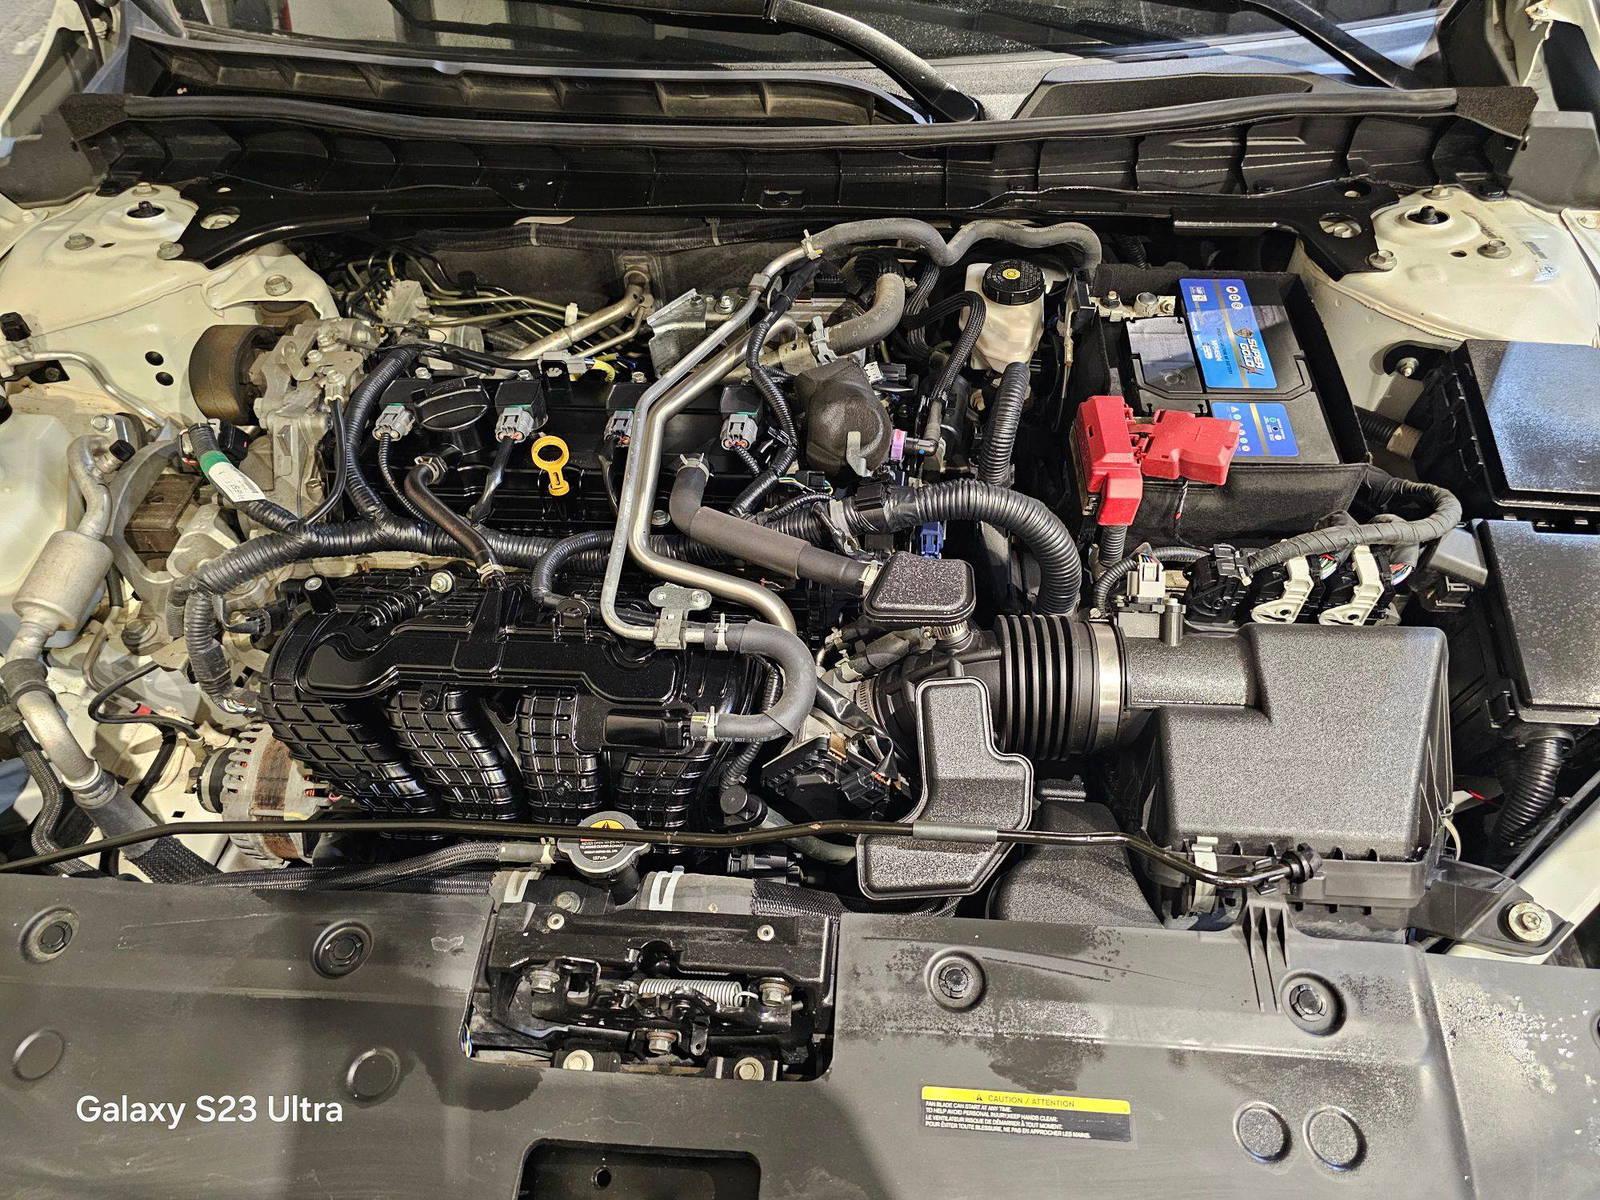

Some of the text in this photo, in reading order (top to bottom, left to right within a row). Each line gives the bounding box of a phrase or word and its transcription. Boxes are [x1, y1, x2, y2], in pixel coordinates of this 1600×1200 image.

[1240, 343, 1255, 368] GOLD
[1247, 338, 1265, 369] SUPER
[987, 1094, 1023, 1104] CAUTION
[1031, 1098, 1075, 1107] ATTENTION
[963, 1110, 990, 1118] PERSONAL
